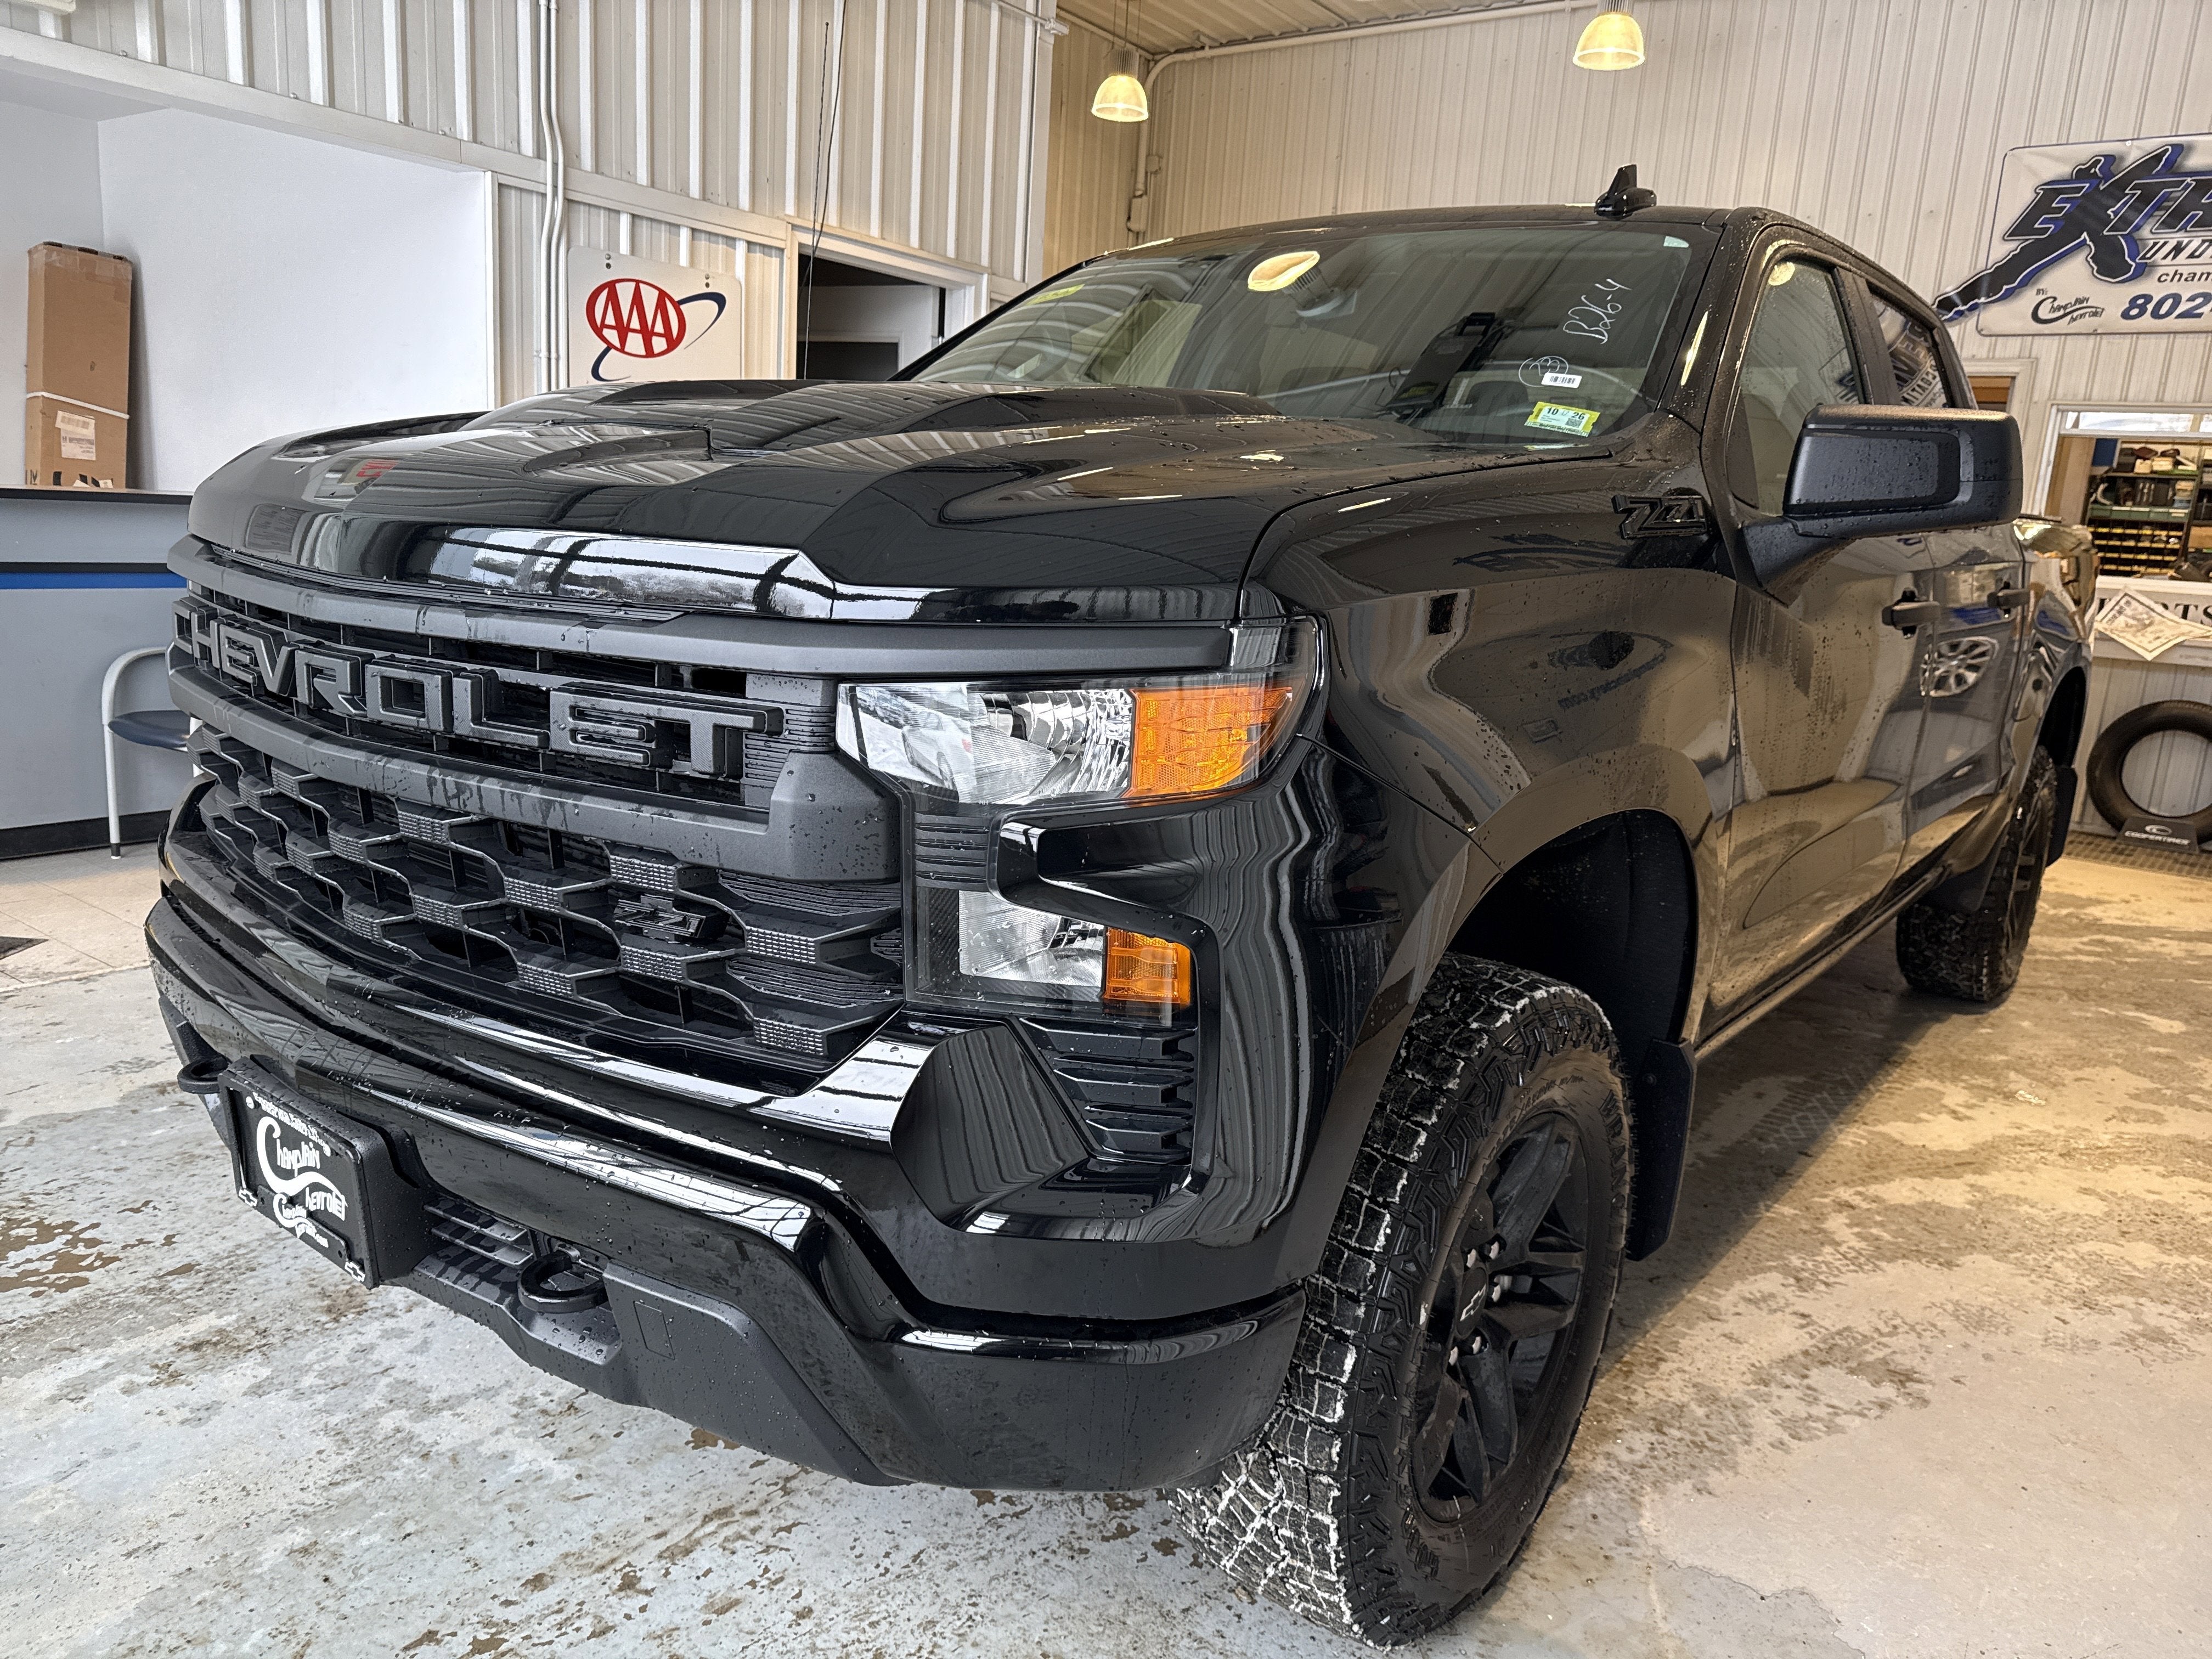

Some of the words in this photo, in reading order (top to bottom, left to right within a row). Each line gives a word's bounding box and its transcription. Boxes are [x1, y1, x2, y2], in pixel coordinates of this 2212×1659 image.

[595, 279, 680, 358] AAA
[1547, 407, 1559, 415] 10
[1571, 411, 1586, 420] 26
[1611, 494, 1707, 540] Z71
[172, 597, 781, 777] CHEVROLET
